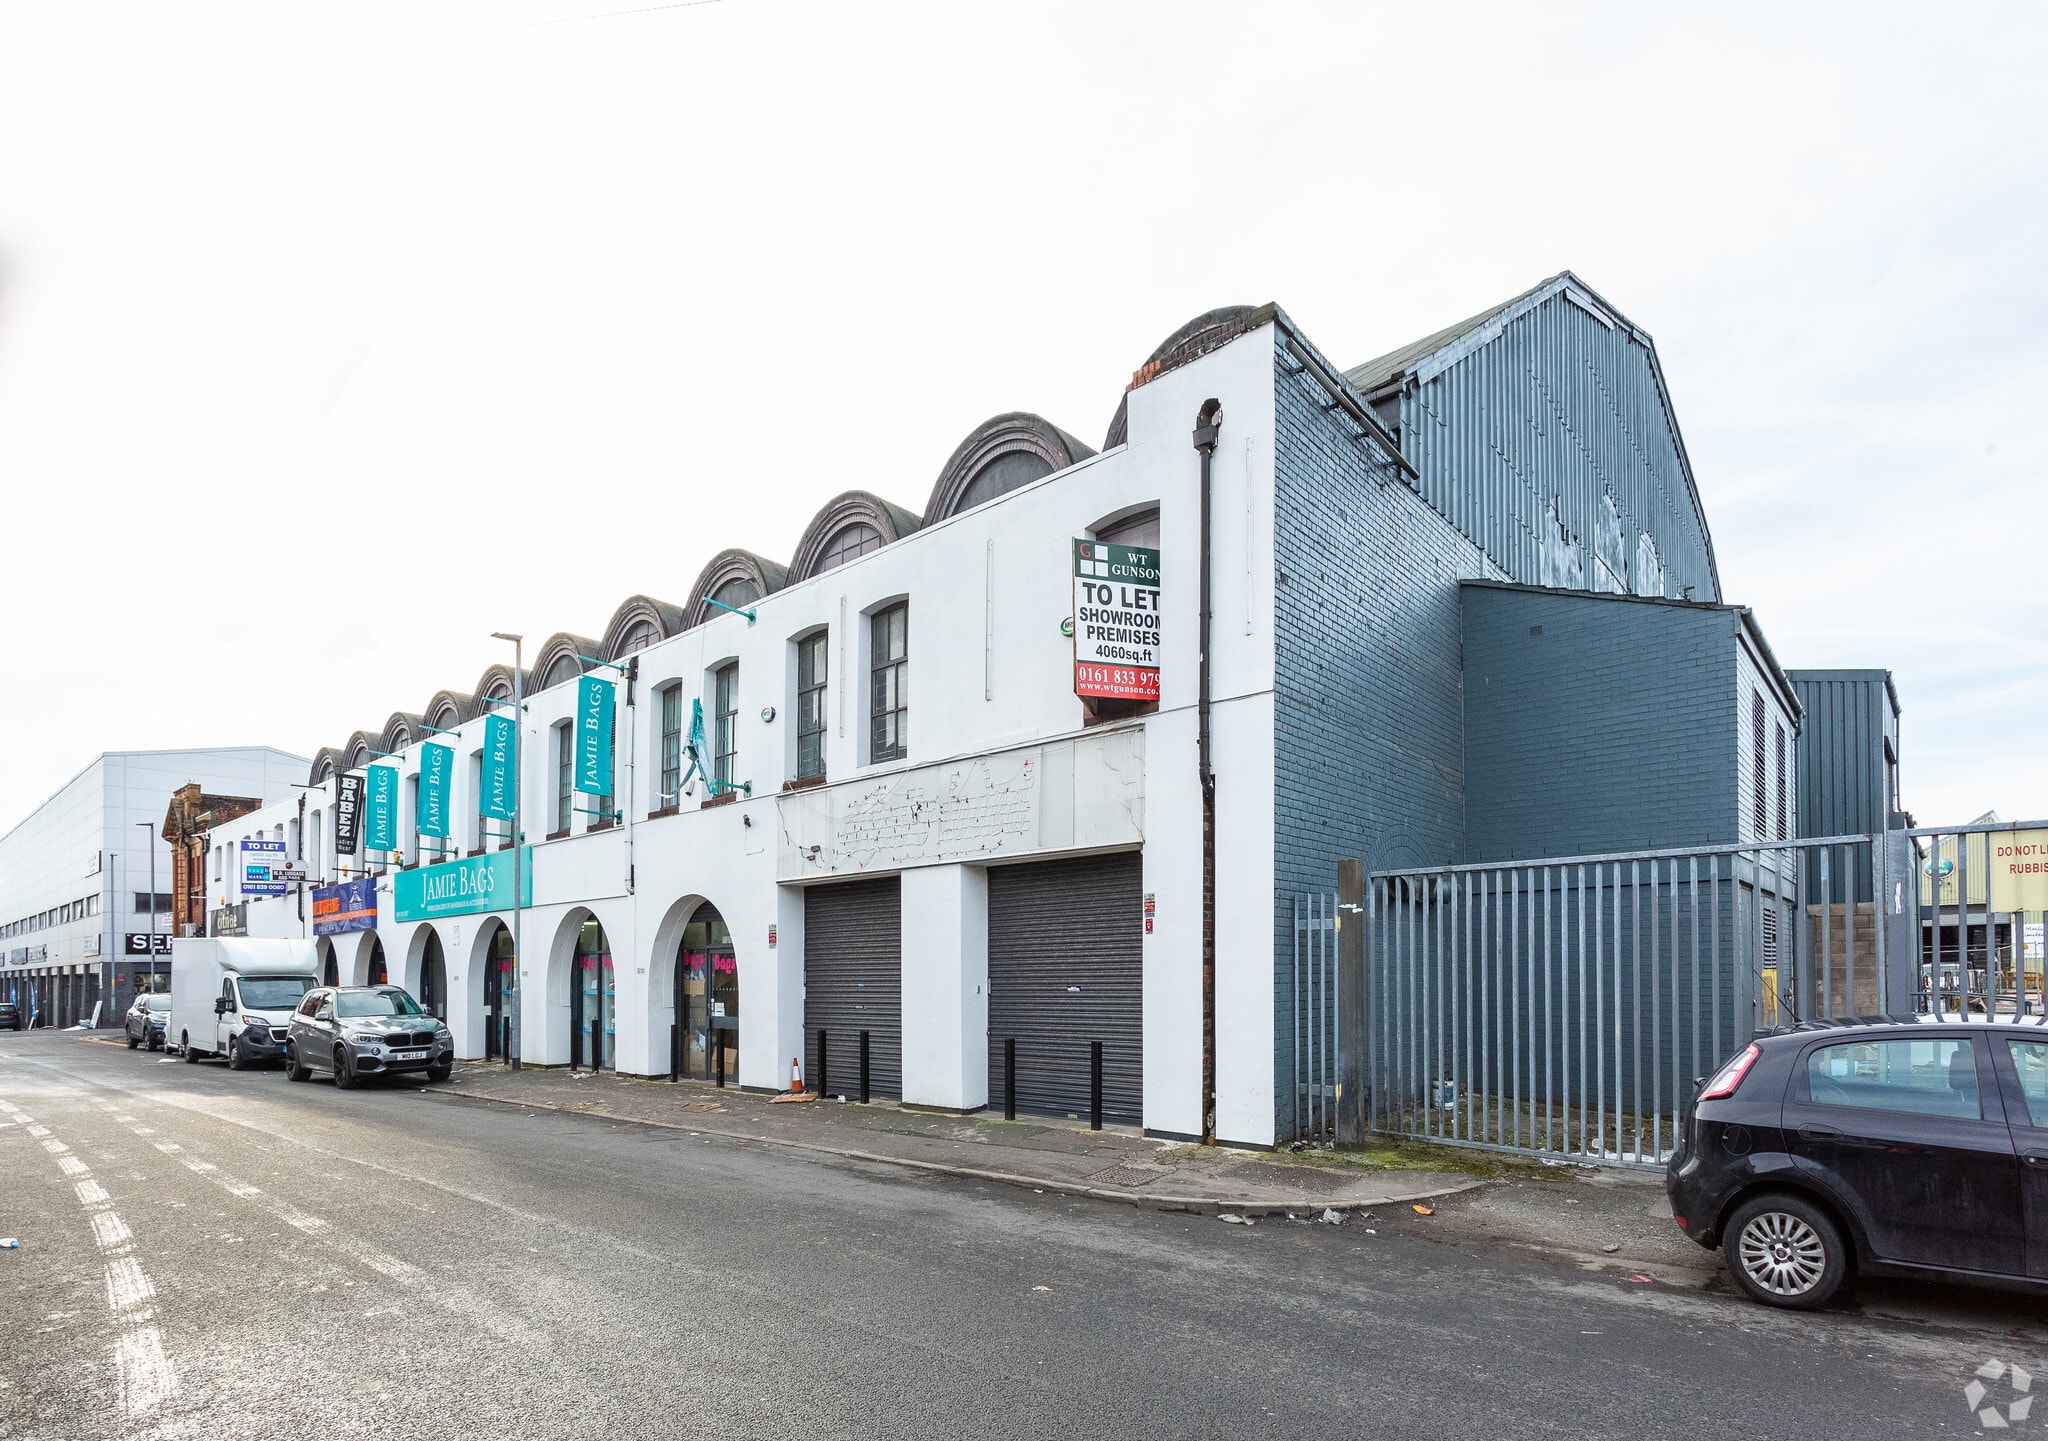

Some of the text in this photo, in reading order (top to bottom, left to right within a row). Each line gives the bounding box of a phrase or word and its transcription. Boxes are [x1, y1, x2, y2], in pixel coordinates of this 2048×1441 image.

[1128, 552, 1148, 566] WT
[1082, 582, 1160, 611] TO LET
[1086, 625, 1160, 646] PREMISES
[1096, 644, 1152, 664] 4060sq.ft
[1079, 666, 1108, 682] 0161
[1114, 670, 1136, 684] 833
[584, 683, 602, 789] JAMIE BAGS
[490, 722, 508, 814] JAMIE BAGS
[426, 748, 442, 832] JAMIE BAGS
[338, 777, 358, 837] BABEZ
[374, 769, 388, 846] JAMIE BAGS
[247, 842, 260, 850] TO
[1998, 844, 2048, 856] DO NOT L
[2010, 862, 2048, 874] RUBBIS
[420, 874, 456, 908] JAMIE
[460, 866, 494, 896] BAGS
